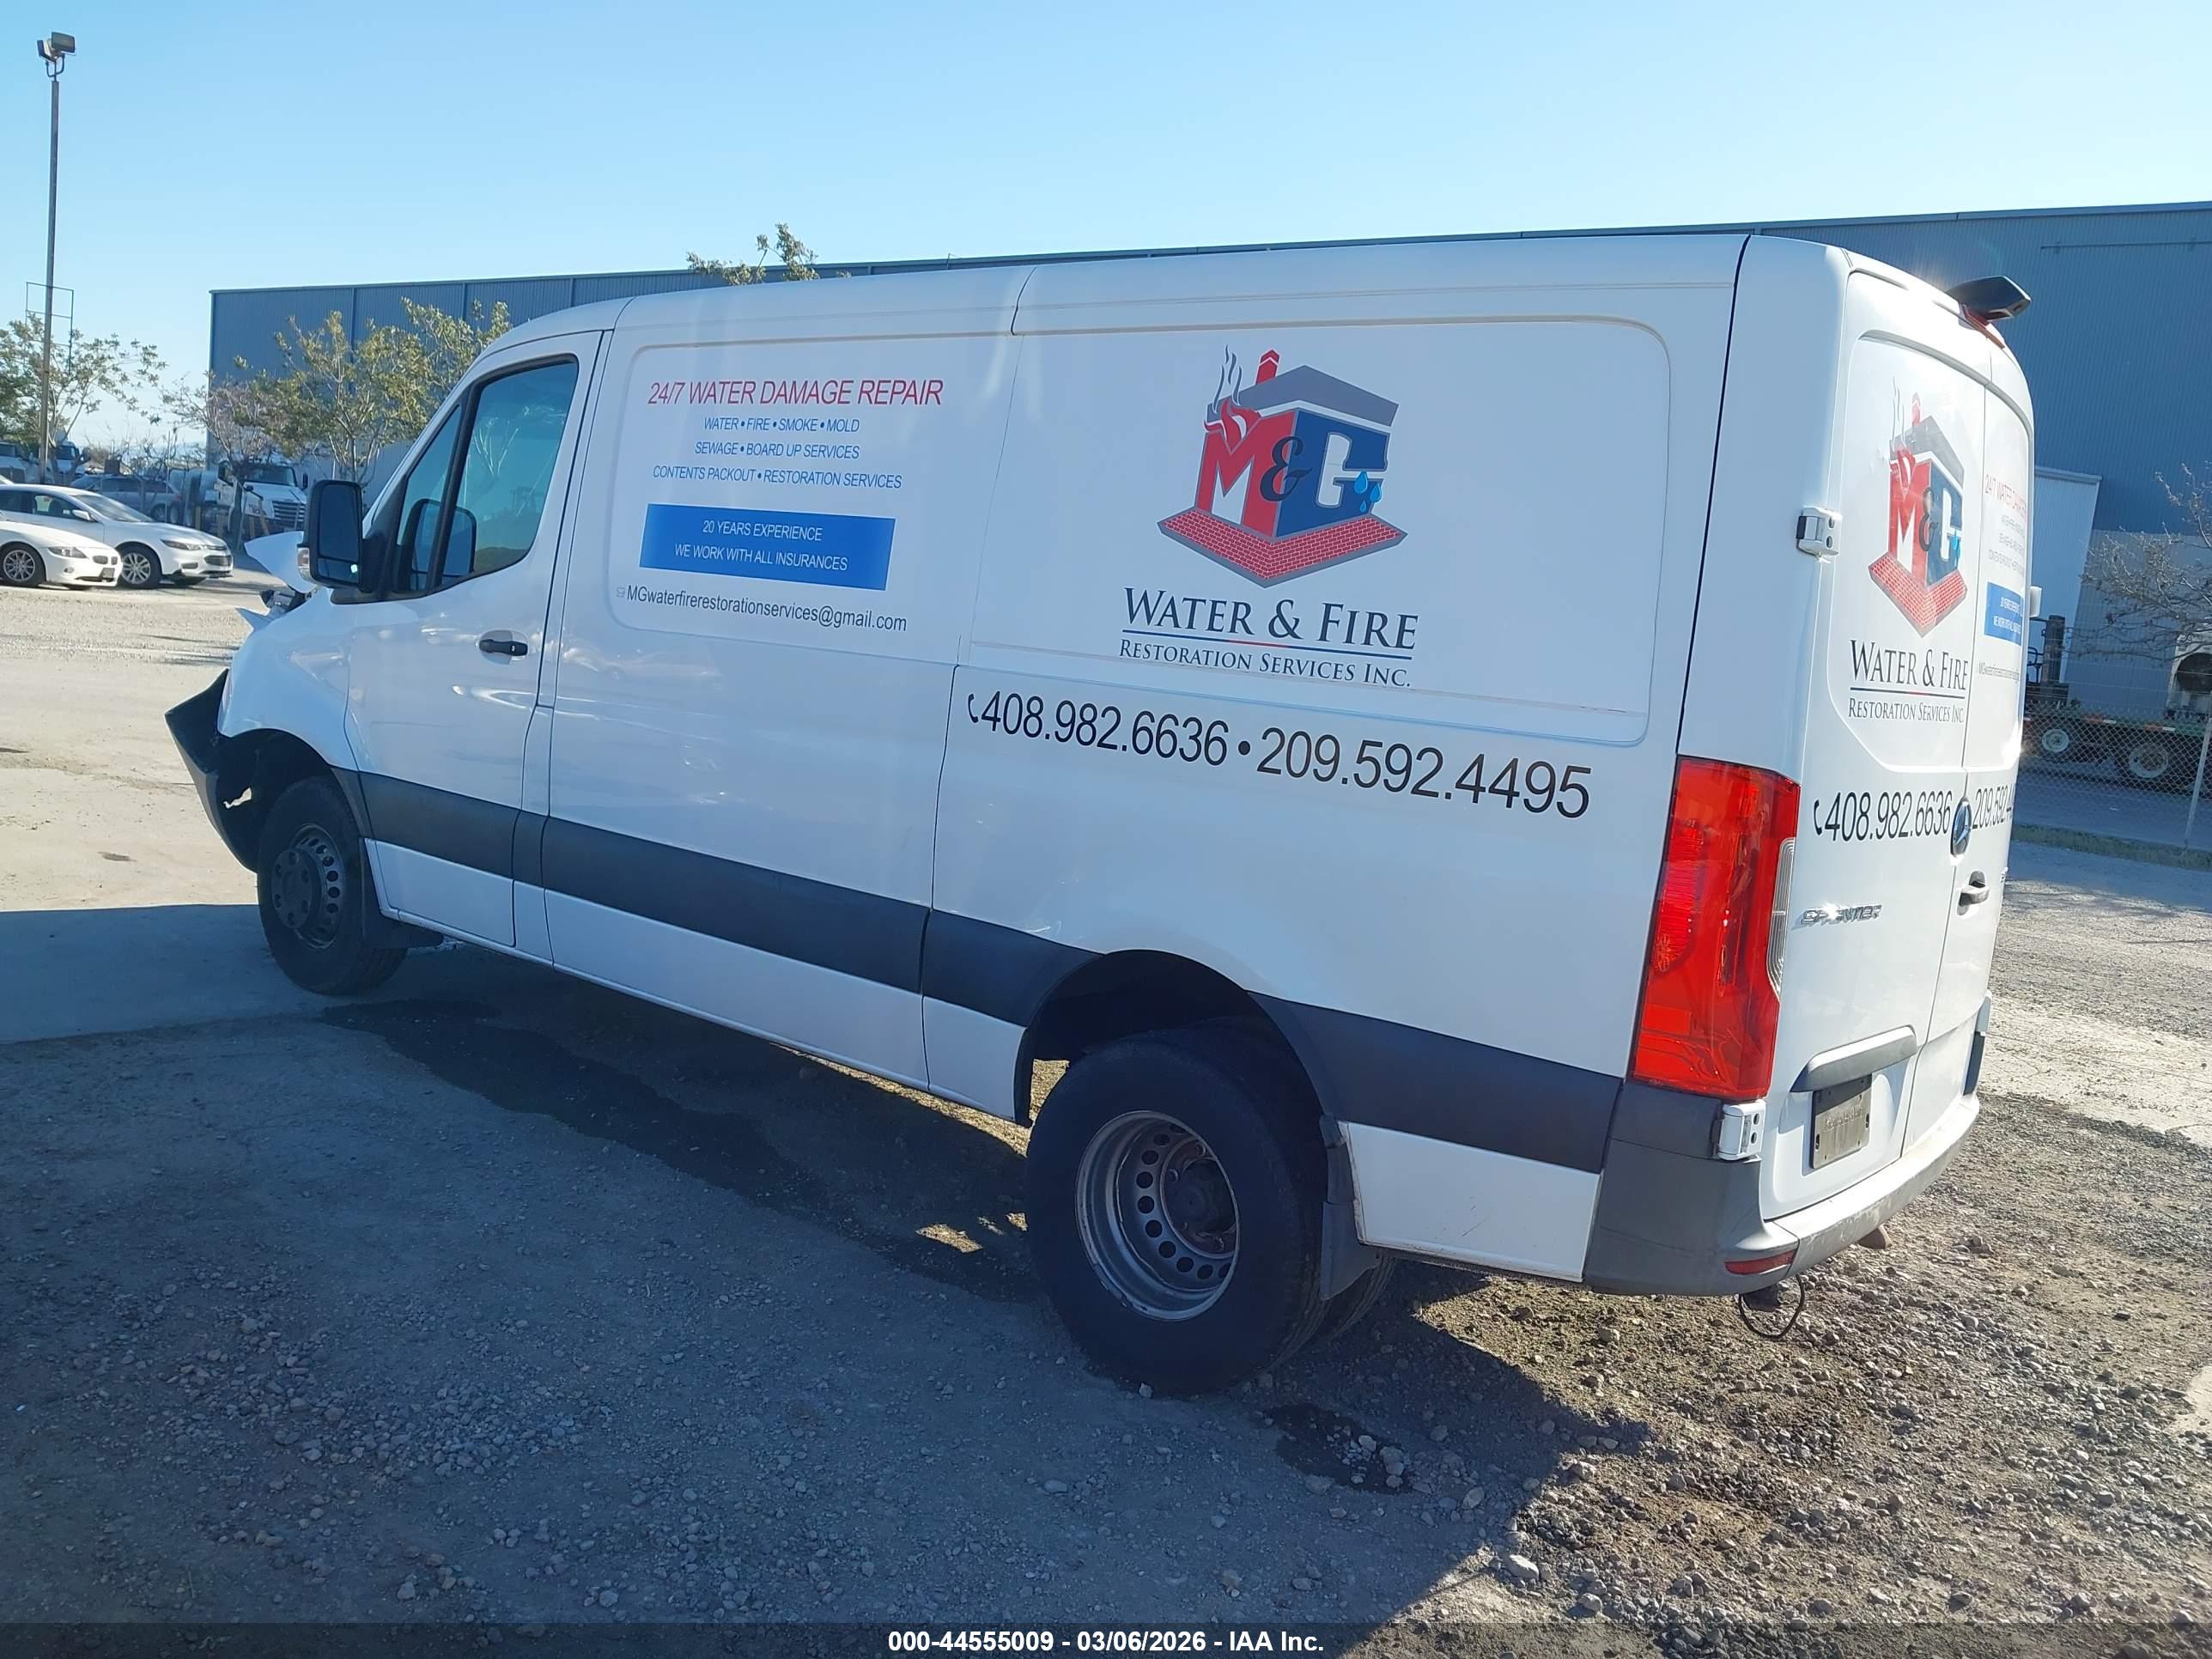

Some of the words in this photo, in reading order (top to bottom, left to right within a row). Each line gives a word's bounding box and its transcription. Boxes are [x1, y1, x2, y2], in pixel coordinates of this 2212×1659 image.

[647, 382, 685, 404] 24/7
[688, 381, 756, 404] WATER
[759, 380, 854, 404] DAMAGE
[857, 380, 944, 405] REPAIR
[703, 417, 739, 431] WATER
[746, 418, 770, 431] FIRE
[778, 418, 818, 432] SMOKE
[826, 419, 860, 432] MOLD
[695, 441, 738, 456] SEWAGE
[746, 443, 785, 457] BOARD
[786, 444, 801, 458] UP
[803, 445, 860, 459] SERVICES
[653, 465, 706, 480] CONTENTS
[707, 467, 756, 482] PACKOUT
[763, 470, 841, 487] RESTORATION
[843, 472, 902, 489] SERVICES
[702, 520, 714, 533] 20
[716, 521, 750, 536] YEARS
[753, 523, 823, 542] EXPERIENCE
[675, 543, 691, 557] WE
[693, 544, 725, 560] WORK
[726, 548, 753, 563] WITH
[755, 550, 773, 564] ALL
[775, 552, 848, 571] INSURANCES
[627, 586, 907, 631] MGwaterfirerestorationservices@gmail.com
[1125, 586, 1255, 636] WATER
[1268, 599, 1304, 640] &
[1316, 602, 1419, 650] FIRE
[1119, 639, 1252, 671] RESTORATION
[1260, 653, 1355, 682] SERVICES
[1363, 664, 1411, 687] INC.
[1850, 639, 1917, 686] WATER
[1922, 649, 1935, 687] &
[1940, 652, 1969, 690] FIRE
[1848, 697, 1915, 721] RESTORATION
[1917, 702, 1949, 722] SERVICES
[981, 690, 1228, 766] 408.982.6636
[1257, 726, 1592, 819] 209.592.4495
[1824, 790, 1953, 842] 408.982.6636
[1802, 904, 1882, 925] SPNTER
